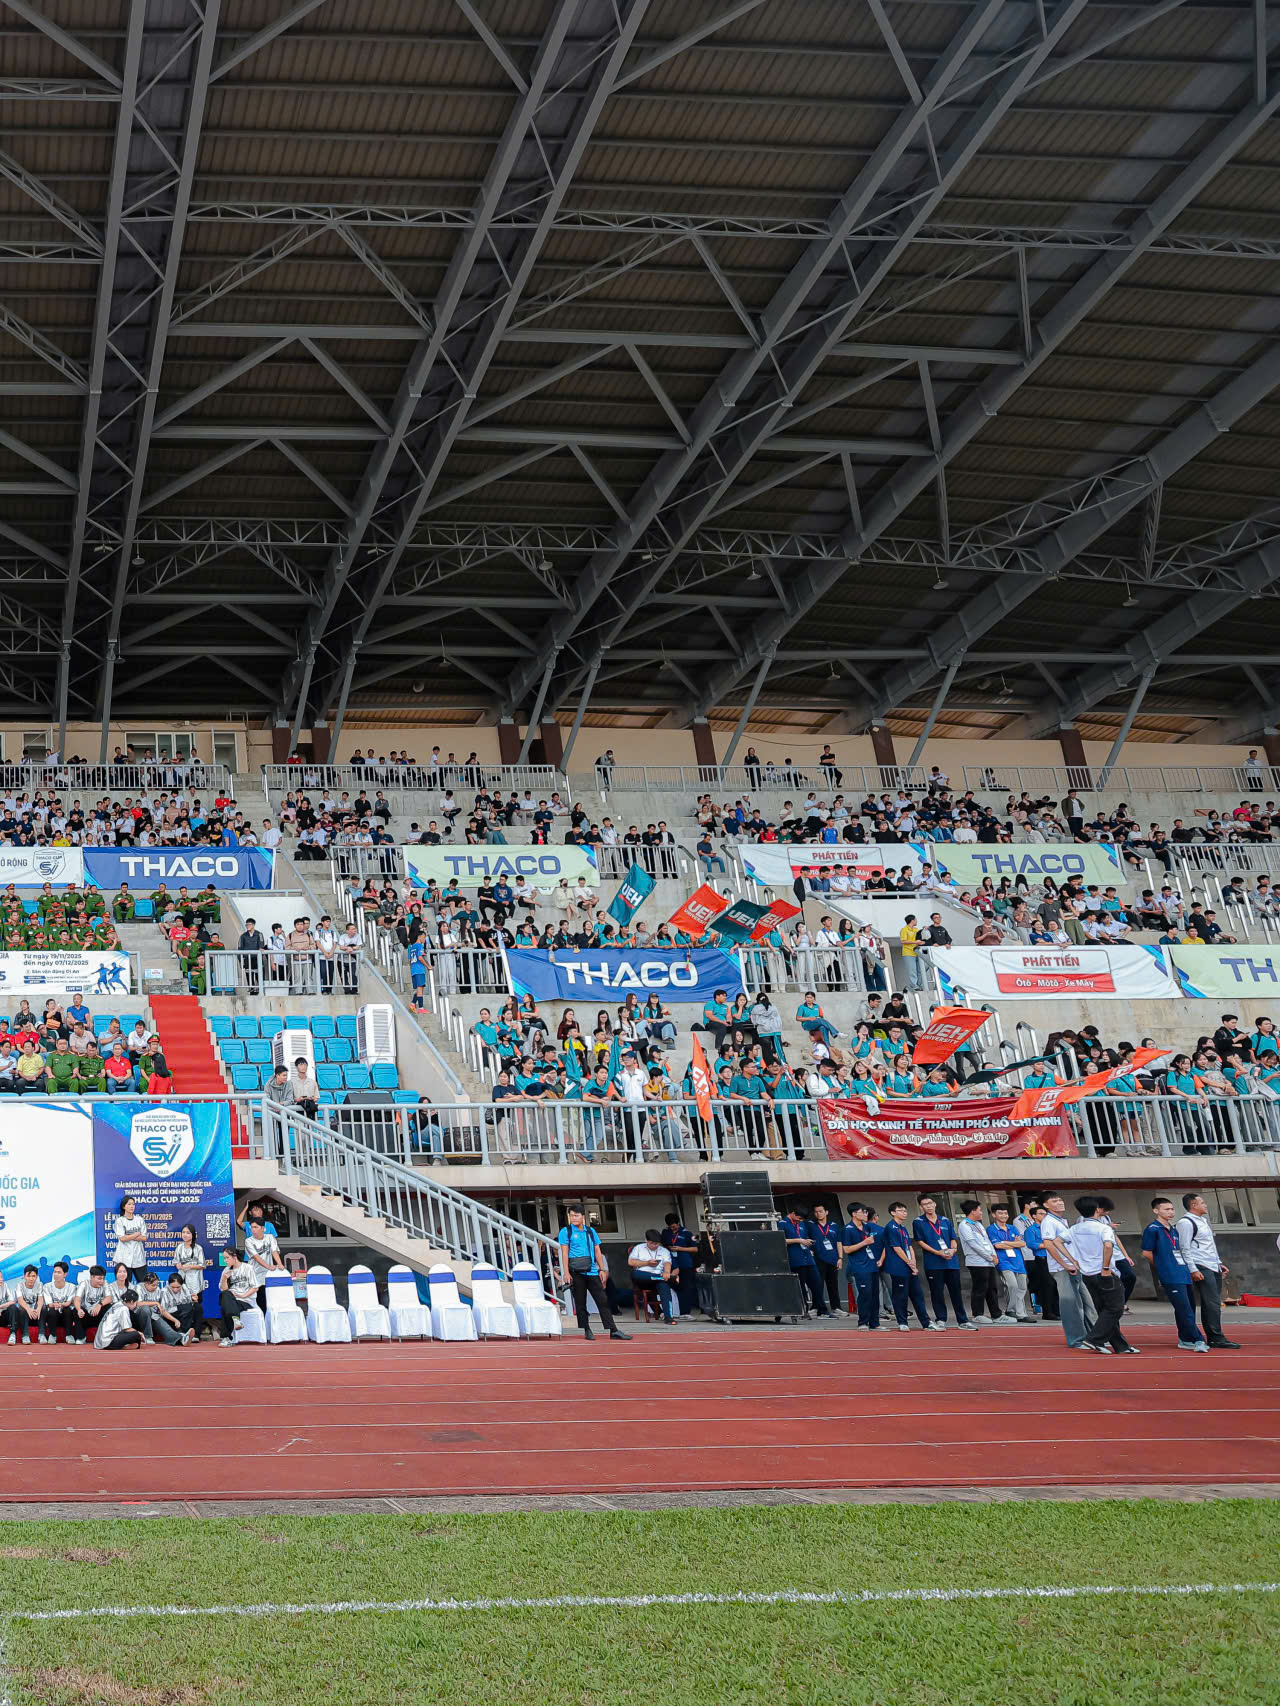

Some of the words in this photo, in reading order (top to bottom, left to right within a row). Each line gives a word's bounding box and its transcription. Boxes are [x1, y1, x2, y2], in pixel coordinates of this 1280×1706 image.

[812, 850, 836, 860] PHÁT
[838, 849, 858, 860] TIẾN
[7, 858, 27, 868] RỘNG
[120, 856, 249, 877] THACO
[444, 855, 561, 876] THACO
[972, 854, 1086, 874] THACO
[621, 882, 644, 907] UEH
[687, 900, 716, 921] UEH
[728, 909, 758, 929] UEH
[0, 952, 9, 960] GIA
[1022, 956, 1051, 967] PHÁT
[1053, 954, 1080, 967] TIẾN
[553, 961, 699, 988] THACO
[1016, 976, 1032, 987] Ôtô
[1037, 977, 1059, 988] Môtô
[1065, 979, 1075, 987] Xe
[1076, 978, 1095, 989] Máy
[921, 1035, 960, 1044] UNIVERSITY
[926, 1023, 970, 1040] UEH
[135, 1125, 167, 1133] THACO
[828, 1120, 848, 1131] ĐẠI
[851, 1120, 876, 1132] HỌC
[878, 1120, 906, 1129] KINH
[908, 1117, 924, 1129] TẾ
[924, 1117, 964, 1129] THÀNH
[966, 1116, 990, 1129] PHỐ
[992, 1116, 1009, 1127] HỒ
[1033, 1116, 1062, 1126] MINH
[143, 1136, 181, 1166] SV
[20, 1177, 40, 1190] GIA
[160, 1196, 179, 1204] CUP
